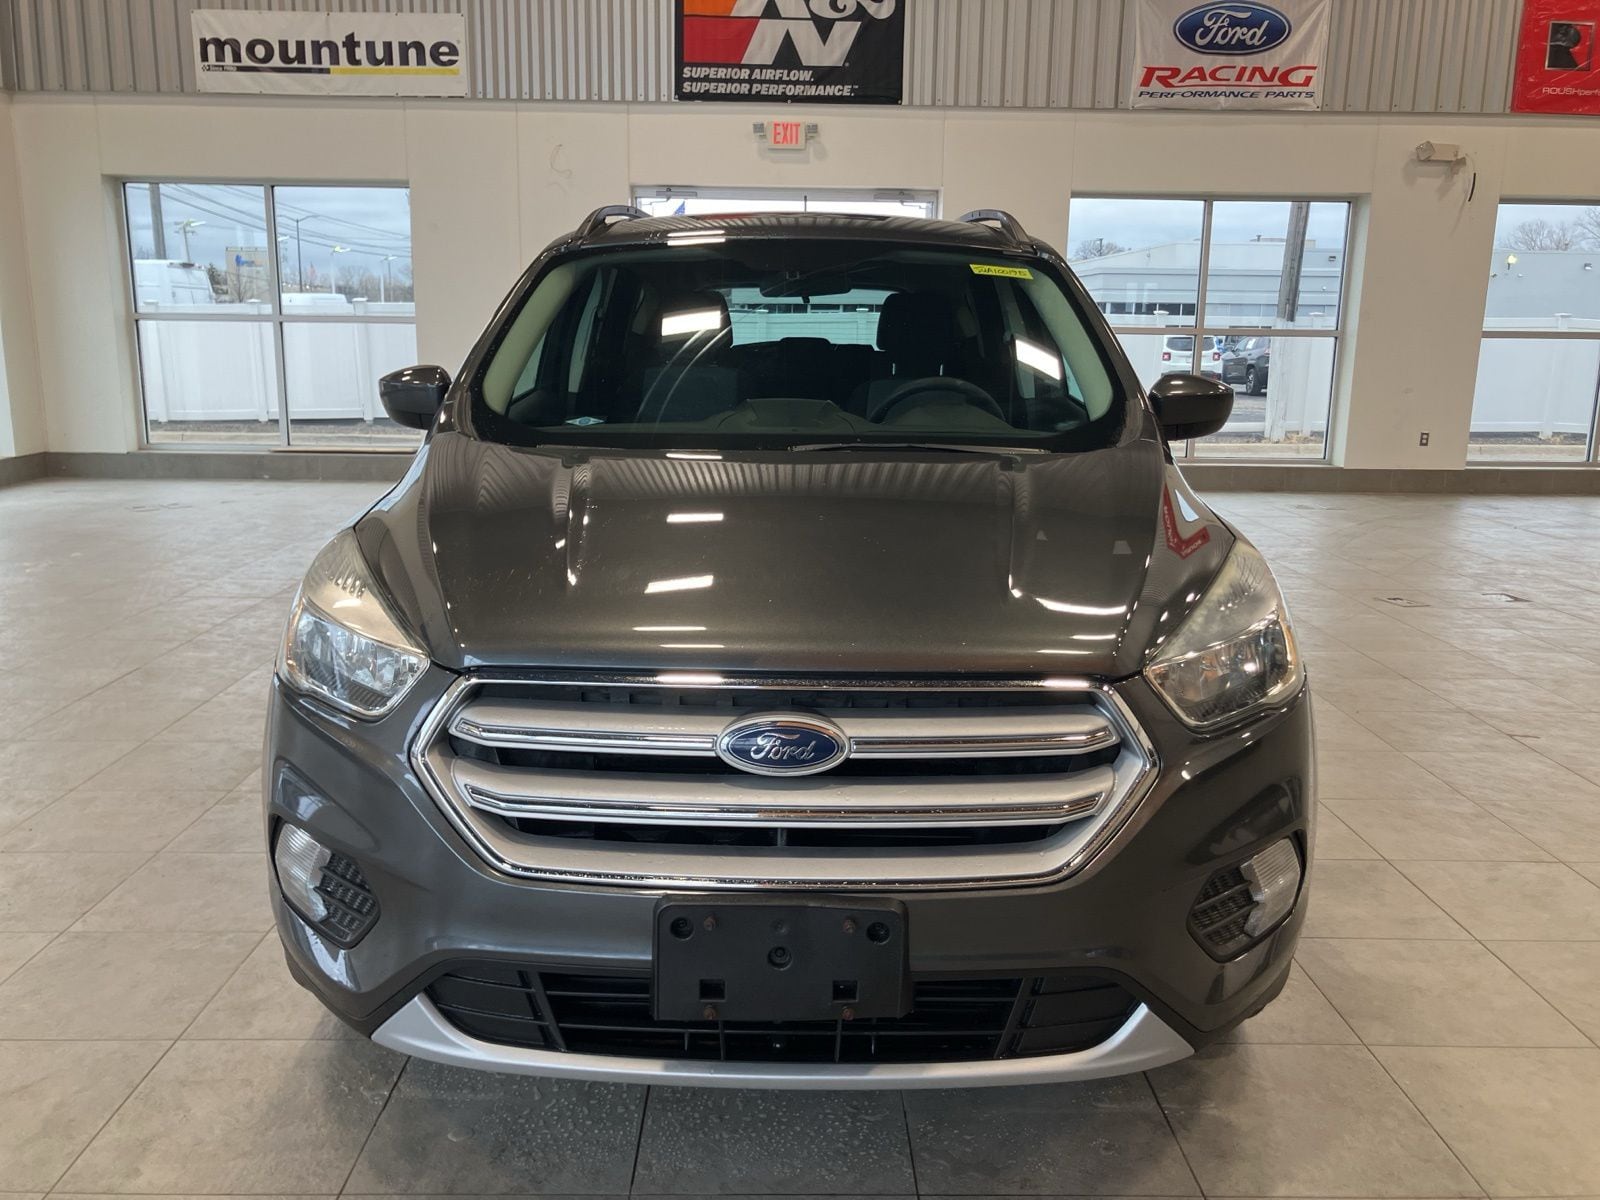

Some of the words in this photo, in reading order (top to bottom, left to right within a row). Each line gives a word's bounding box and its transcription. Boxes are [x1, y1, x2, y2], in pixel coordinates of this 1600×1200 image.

[1194, 9, 1269, 46] Ford
[200, 32, 459, 66] mountune
[682, 66, 750, 80] SUPERIOR
[751, 68, 814, 82] AIRFLOW.
[1139, 65, 1318, 88] RACING
[682, 81, 750, 95] SUPERIOR
[1138, 90, 1261, 99] PERFORMANCE
[1264, 91, 1315, 99] PARTS
[773, 123, 801, 145] EXIT
[750, 732, 817, 760] Ford
